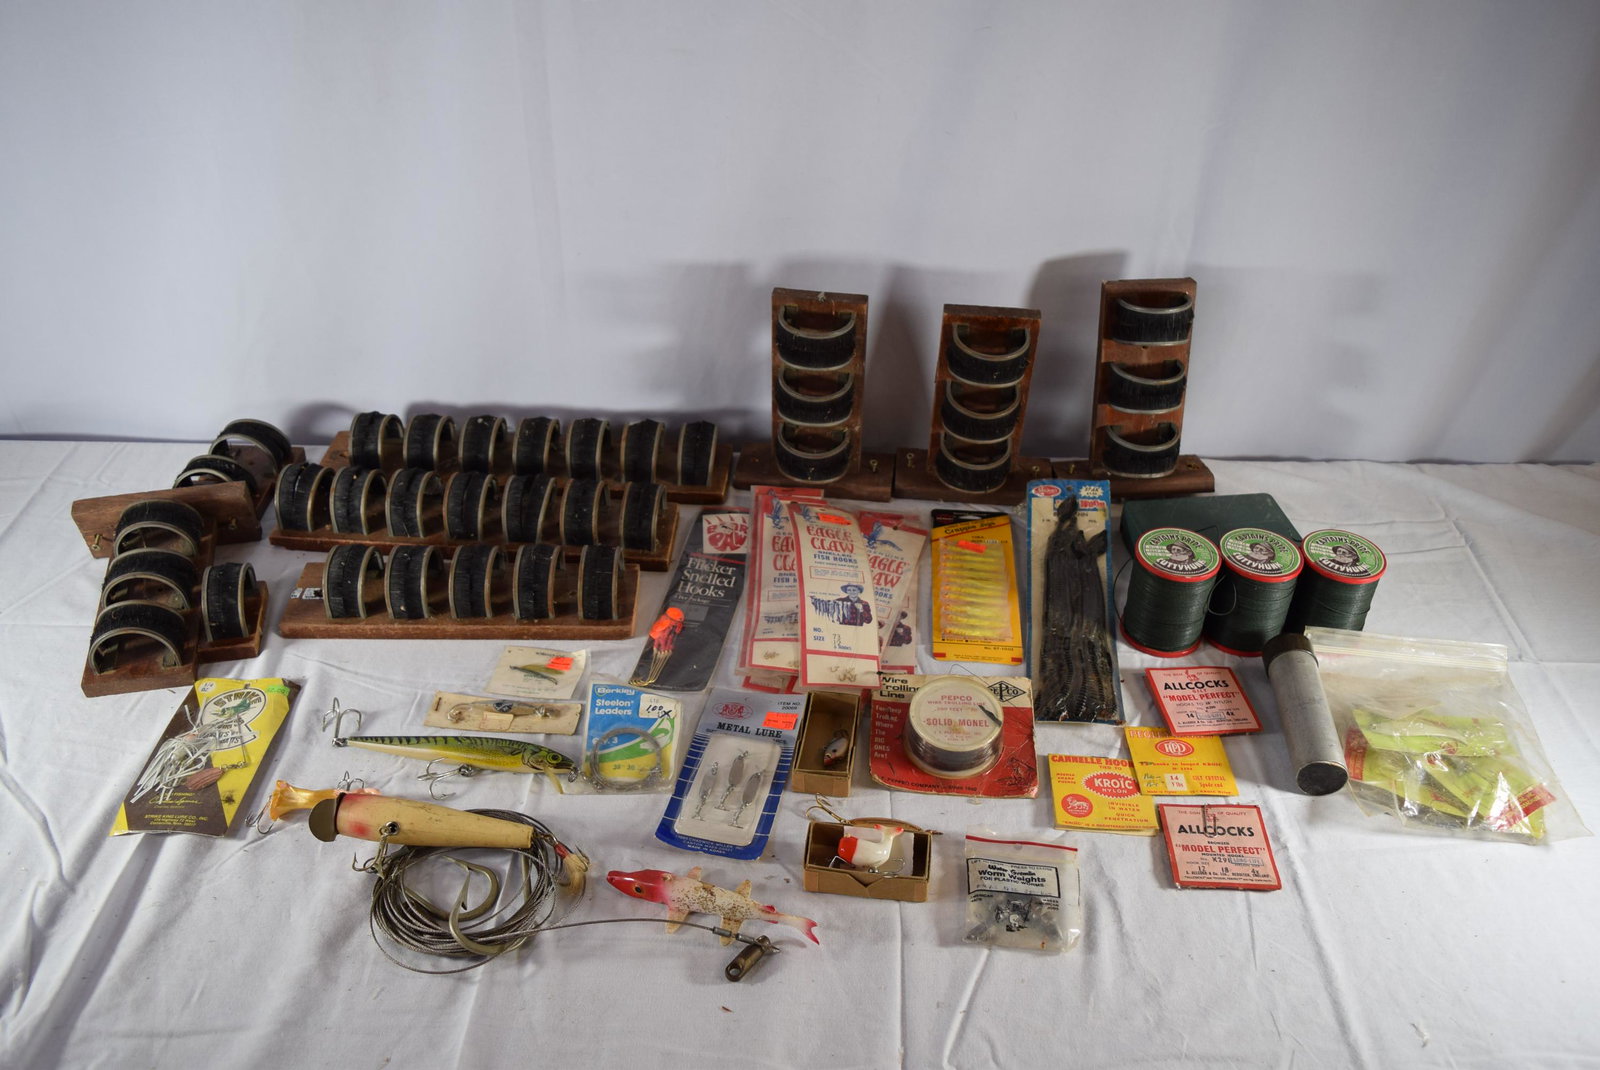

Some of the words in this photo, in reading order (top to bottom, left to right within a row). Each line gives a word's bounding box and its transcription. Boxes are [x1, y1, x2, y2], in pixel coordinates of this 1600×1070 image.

[806, 525, 852, 541] EAGLE
[708, 532, 747, 551] PAW
[811, 537, 854, 553] CLAW
[687, 557, 736, 575] Flicker
[833, 556, 858, 564] HOOKS
[868, 555, 905, 575] AGLE
[682, 570, 736, 587] Snelled
[678, 581, 725, 597] Hooks
[597, 687, 635, 695] Berkley
[990, 682, 1019, 700] EPCO
[1164, 680, 1229, 690] ALLCOCKS
[213, 691, 262, 707] STRIKE
[1163, 694, 1198, 702] "MODEL
[1200, 692, 1240, 701] PERFECT"
[716, 722, 750, 734] METAL
[755, 728, 783, 738] LURE
[926, 718, 952, 726] SOLID
[959, 719, 989, 727] MONEL
[1051, 755, 1102, 764] CANNELLE
[1178, 825, 1254, 837] ALLCOCKS
[1175, 844, 1215, 852] "MODEL
[1218, 845, 1265, 855] PERFECT"
[978, 869, 1005, 877] Worm
[1008, 874, 1046, 883] Weights
